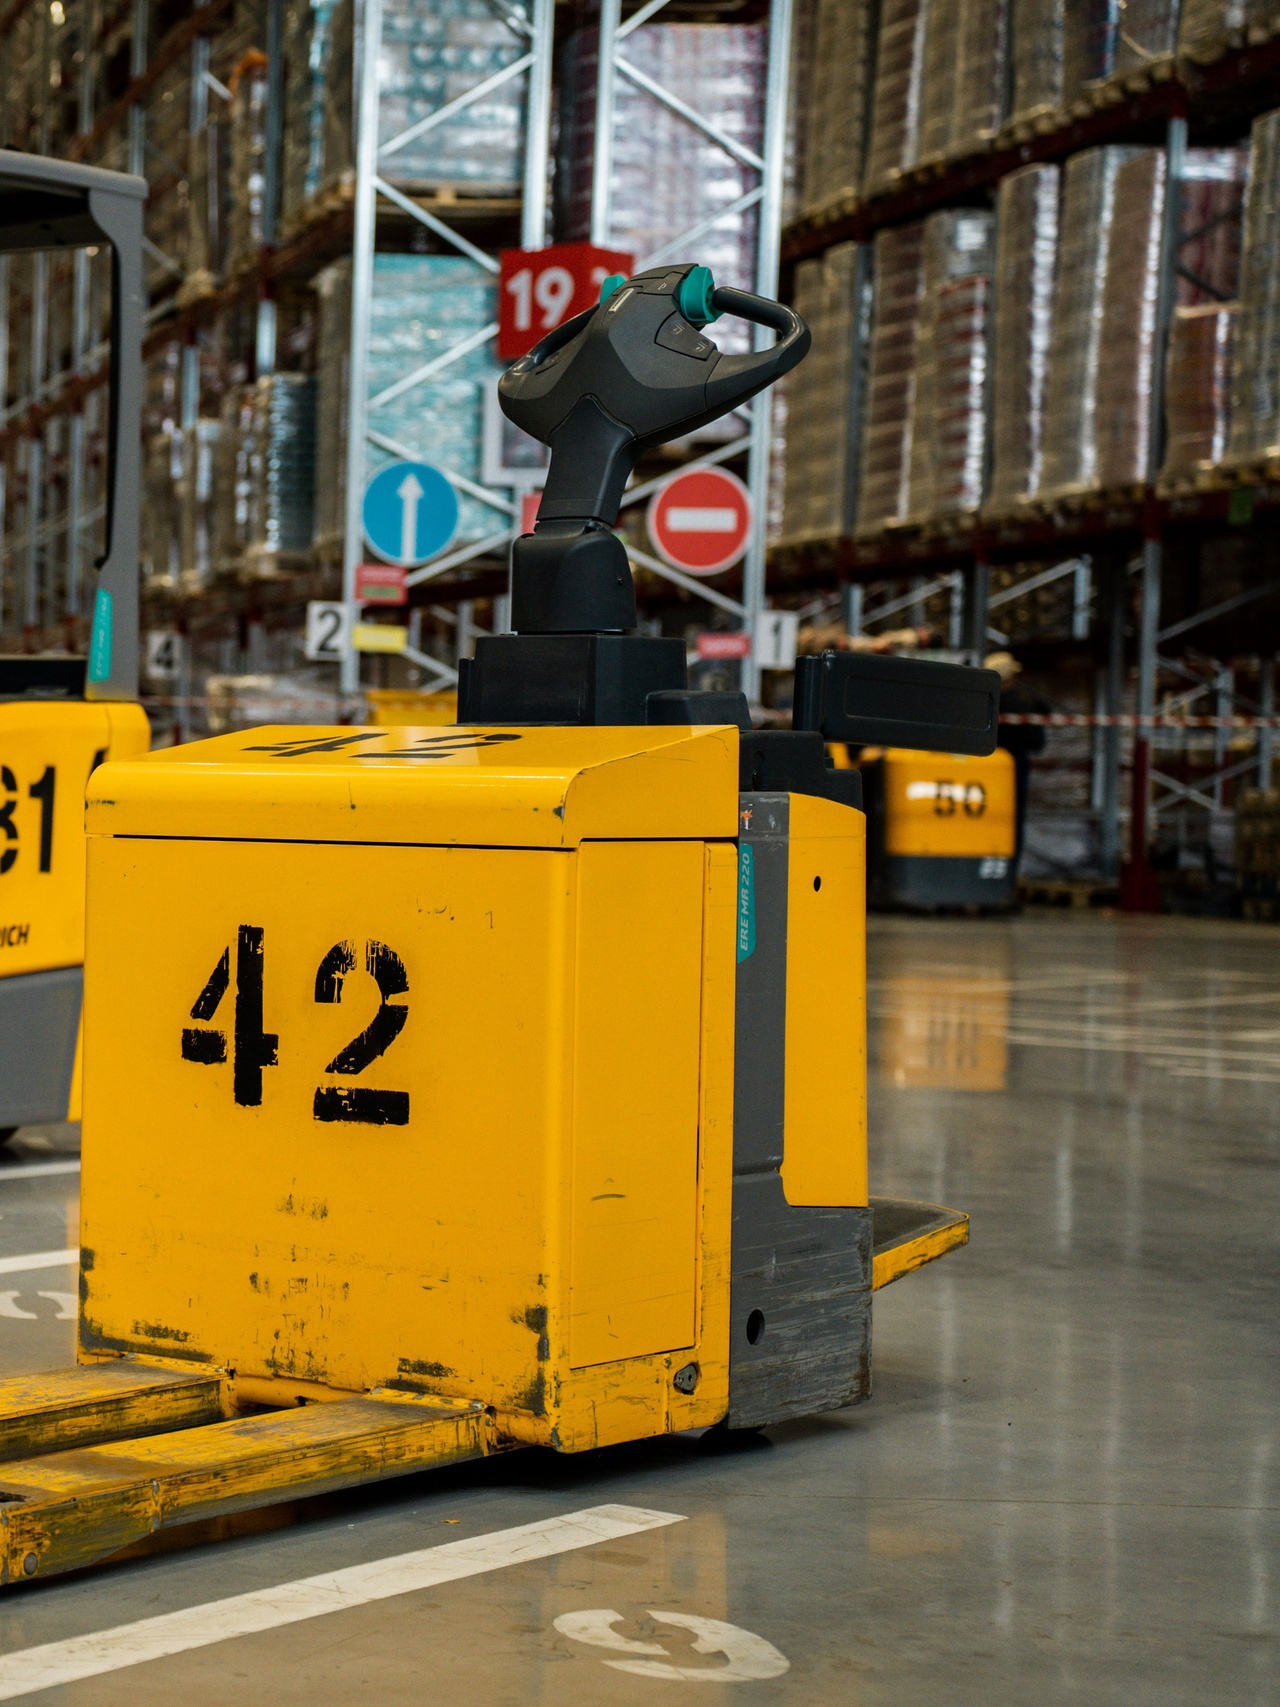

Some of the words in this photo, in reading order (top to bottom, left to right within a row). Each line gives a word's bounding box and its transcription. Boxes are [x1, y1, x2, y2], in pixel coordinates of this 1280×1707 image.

[506, 266, 575, 331] 19
[318, 609, 341, 653] 2
[155, 638, 175, 672] 4
[240, 733, 523, 758] 42
[934, 779, 987, 819] 50
[742, 853, 750, 886] 220
[181, 924, 410, 1126] 42
